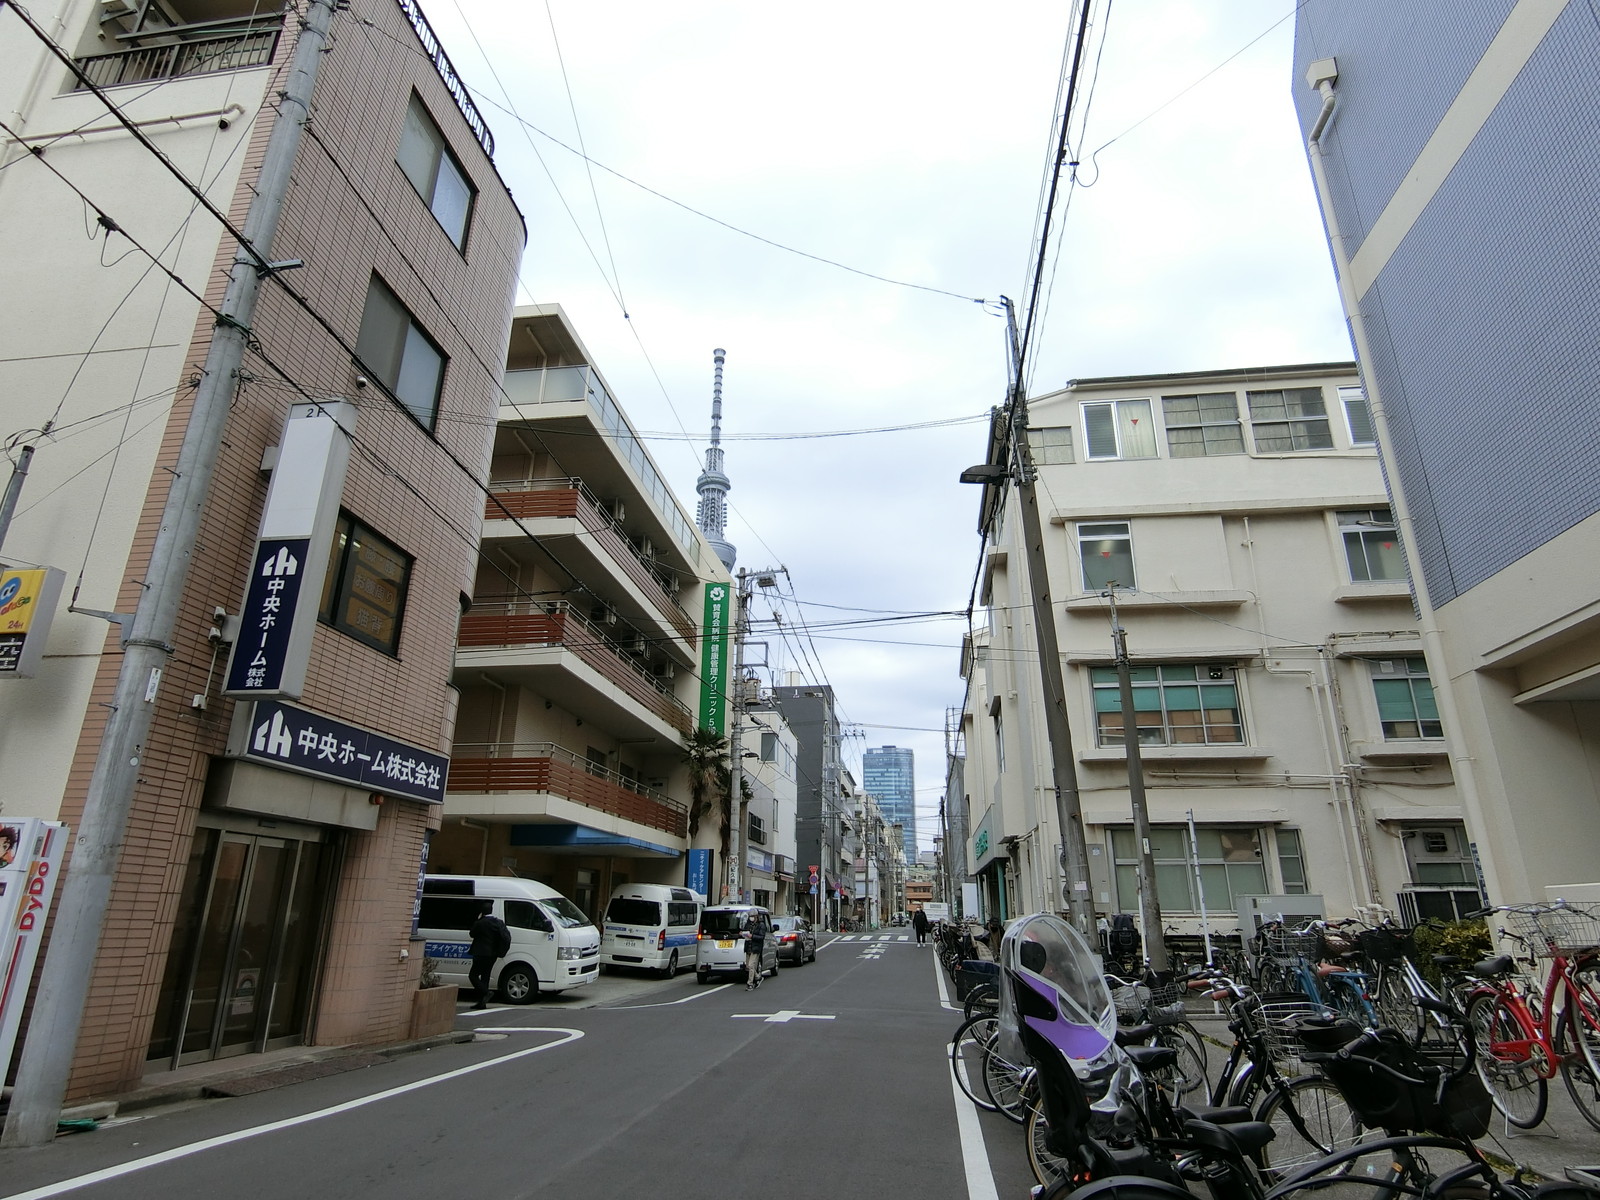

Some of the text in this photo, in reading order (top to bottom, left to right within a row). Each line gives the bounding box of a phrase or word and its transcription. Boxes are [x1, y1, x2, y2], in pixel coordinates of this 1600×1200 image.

[250, 577, 285, 667] 中央ホーム
[245, 678, 263, 688] 会社
[247, 667, 267, 677] 株式
[297, 726, 441, 791] 中央ホーム株式会社
[19, 861, 50, 930] DyDo
